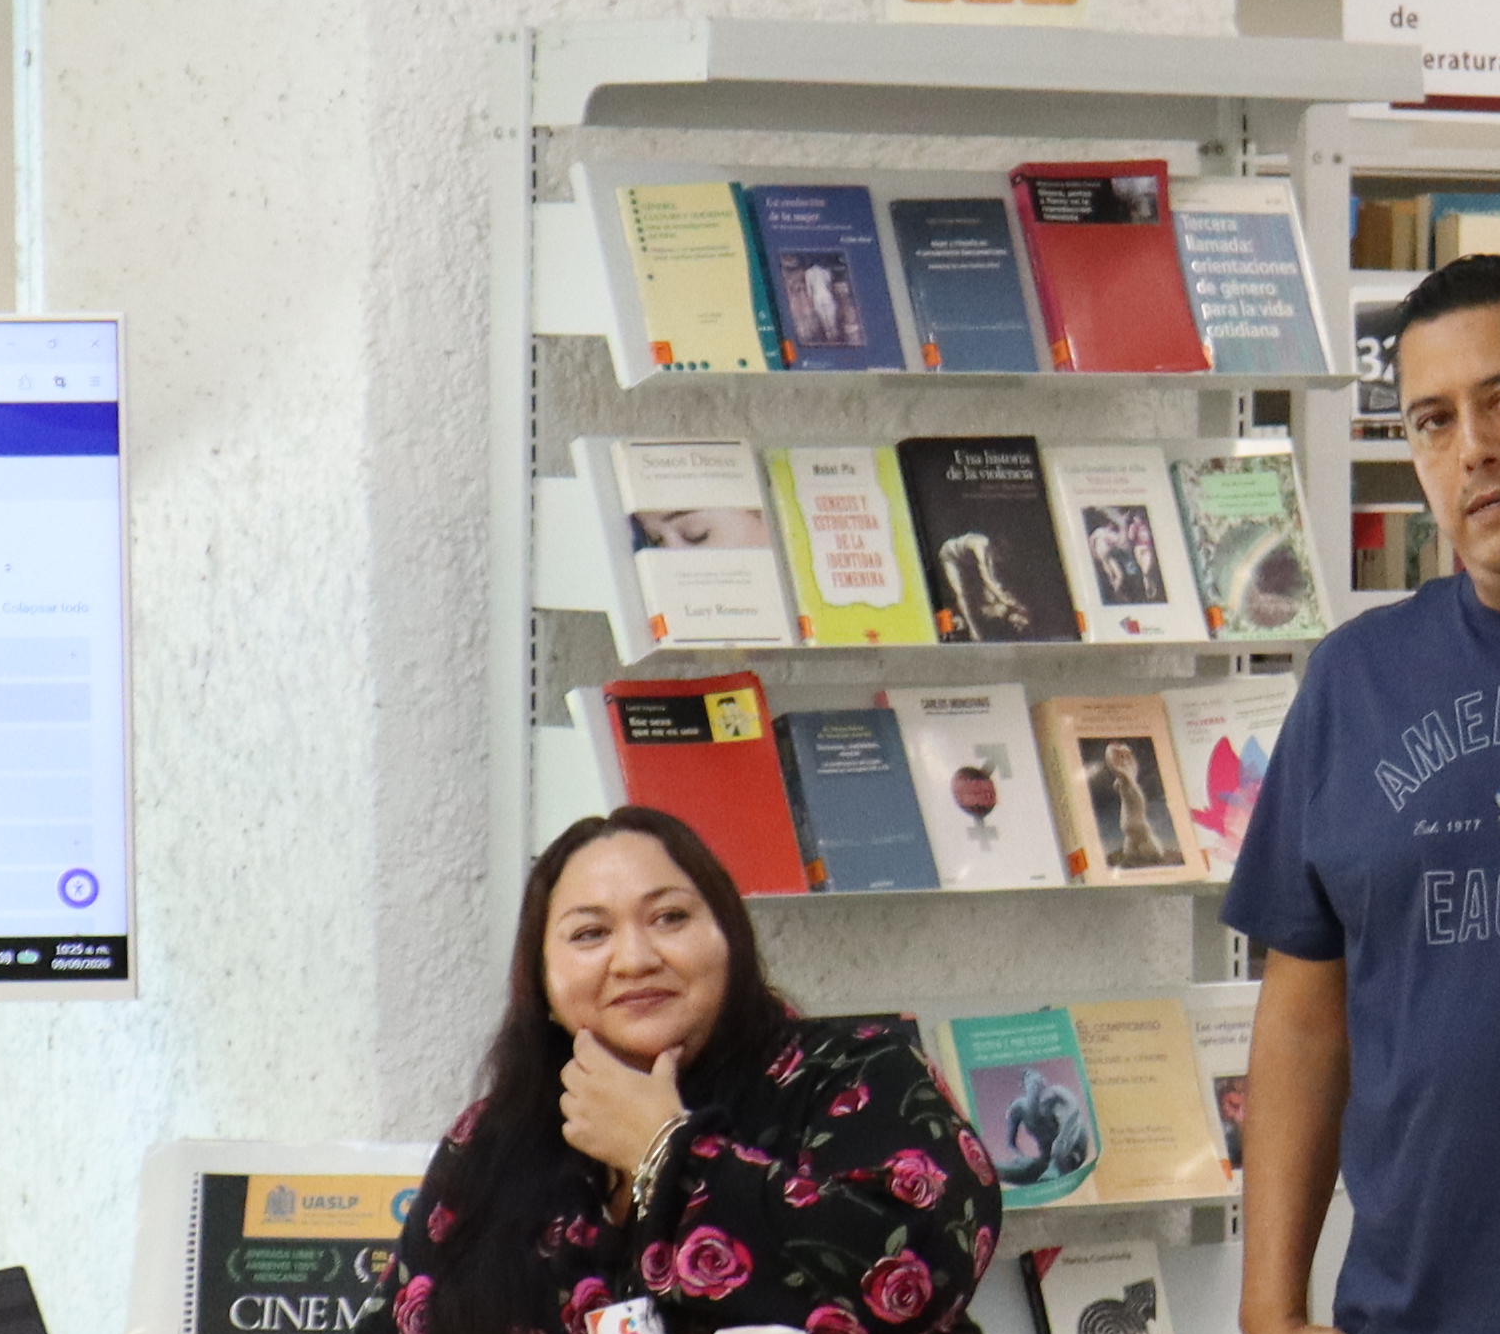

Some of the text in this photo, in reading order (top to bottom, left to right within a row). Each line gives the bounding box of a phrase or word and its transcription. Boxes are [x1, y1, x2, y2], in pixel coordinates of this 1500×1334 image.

[1390, 7, 1418, 31] de
[1179, 214, 1237, 232] Tercera
[1185, 234, 1252, 253] llamada:
[1191, 257, 1298, 275] orientaciones
[1196, 278, 1277, 298] de género
[1202, 299, 1295, 320] para la vida
[1206, 321, 1280, 338] cotidiana
[946, 466, 1035, 481] de la violencia
[1446, 818, 1482, 834] 1977
[302, 1195, 361, 1210] UASLP
[228, 1295, 330, 1332] CINE
